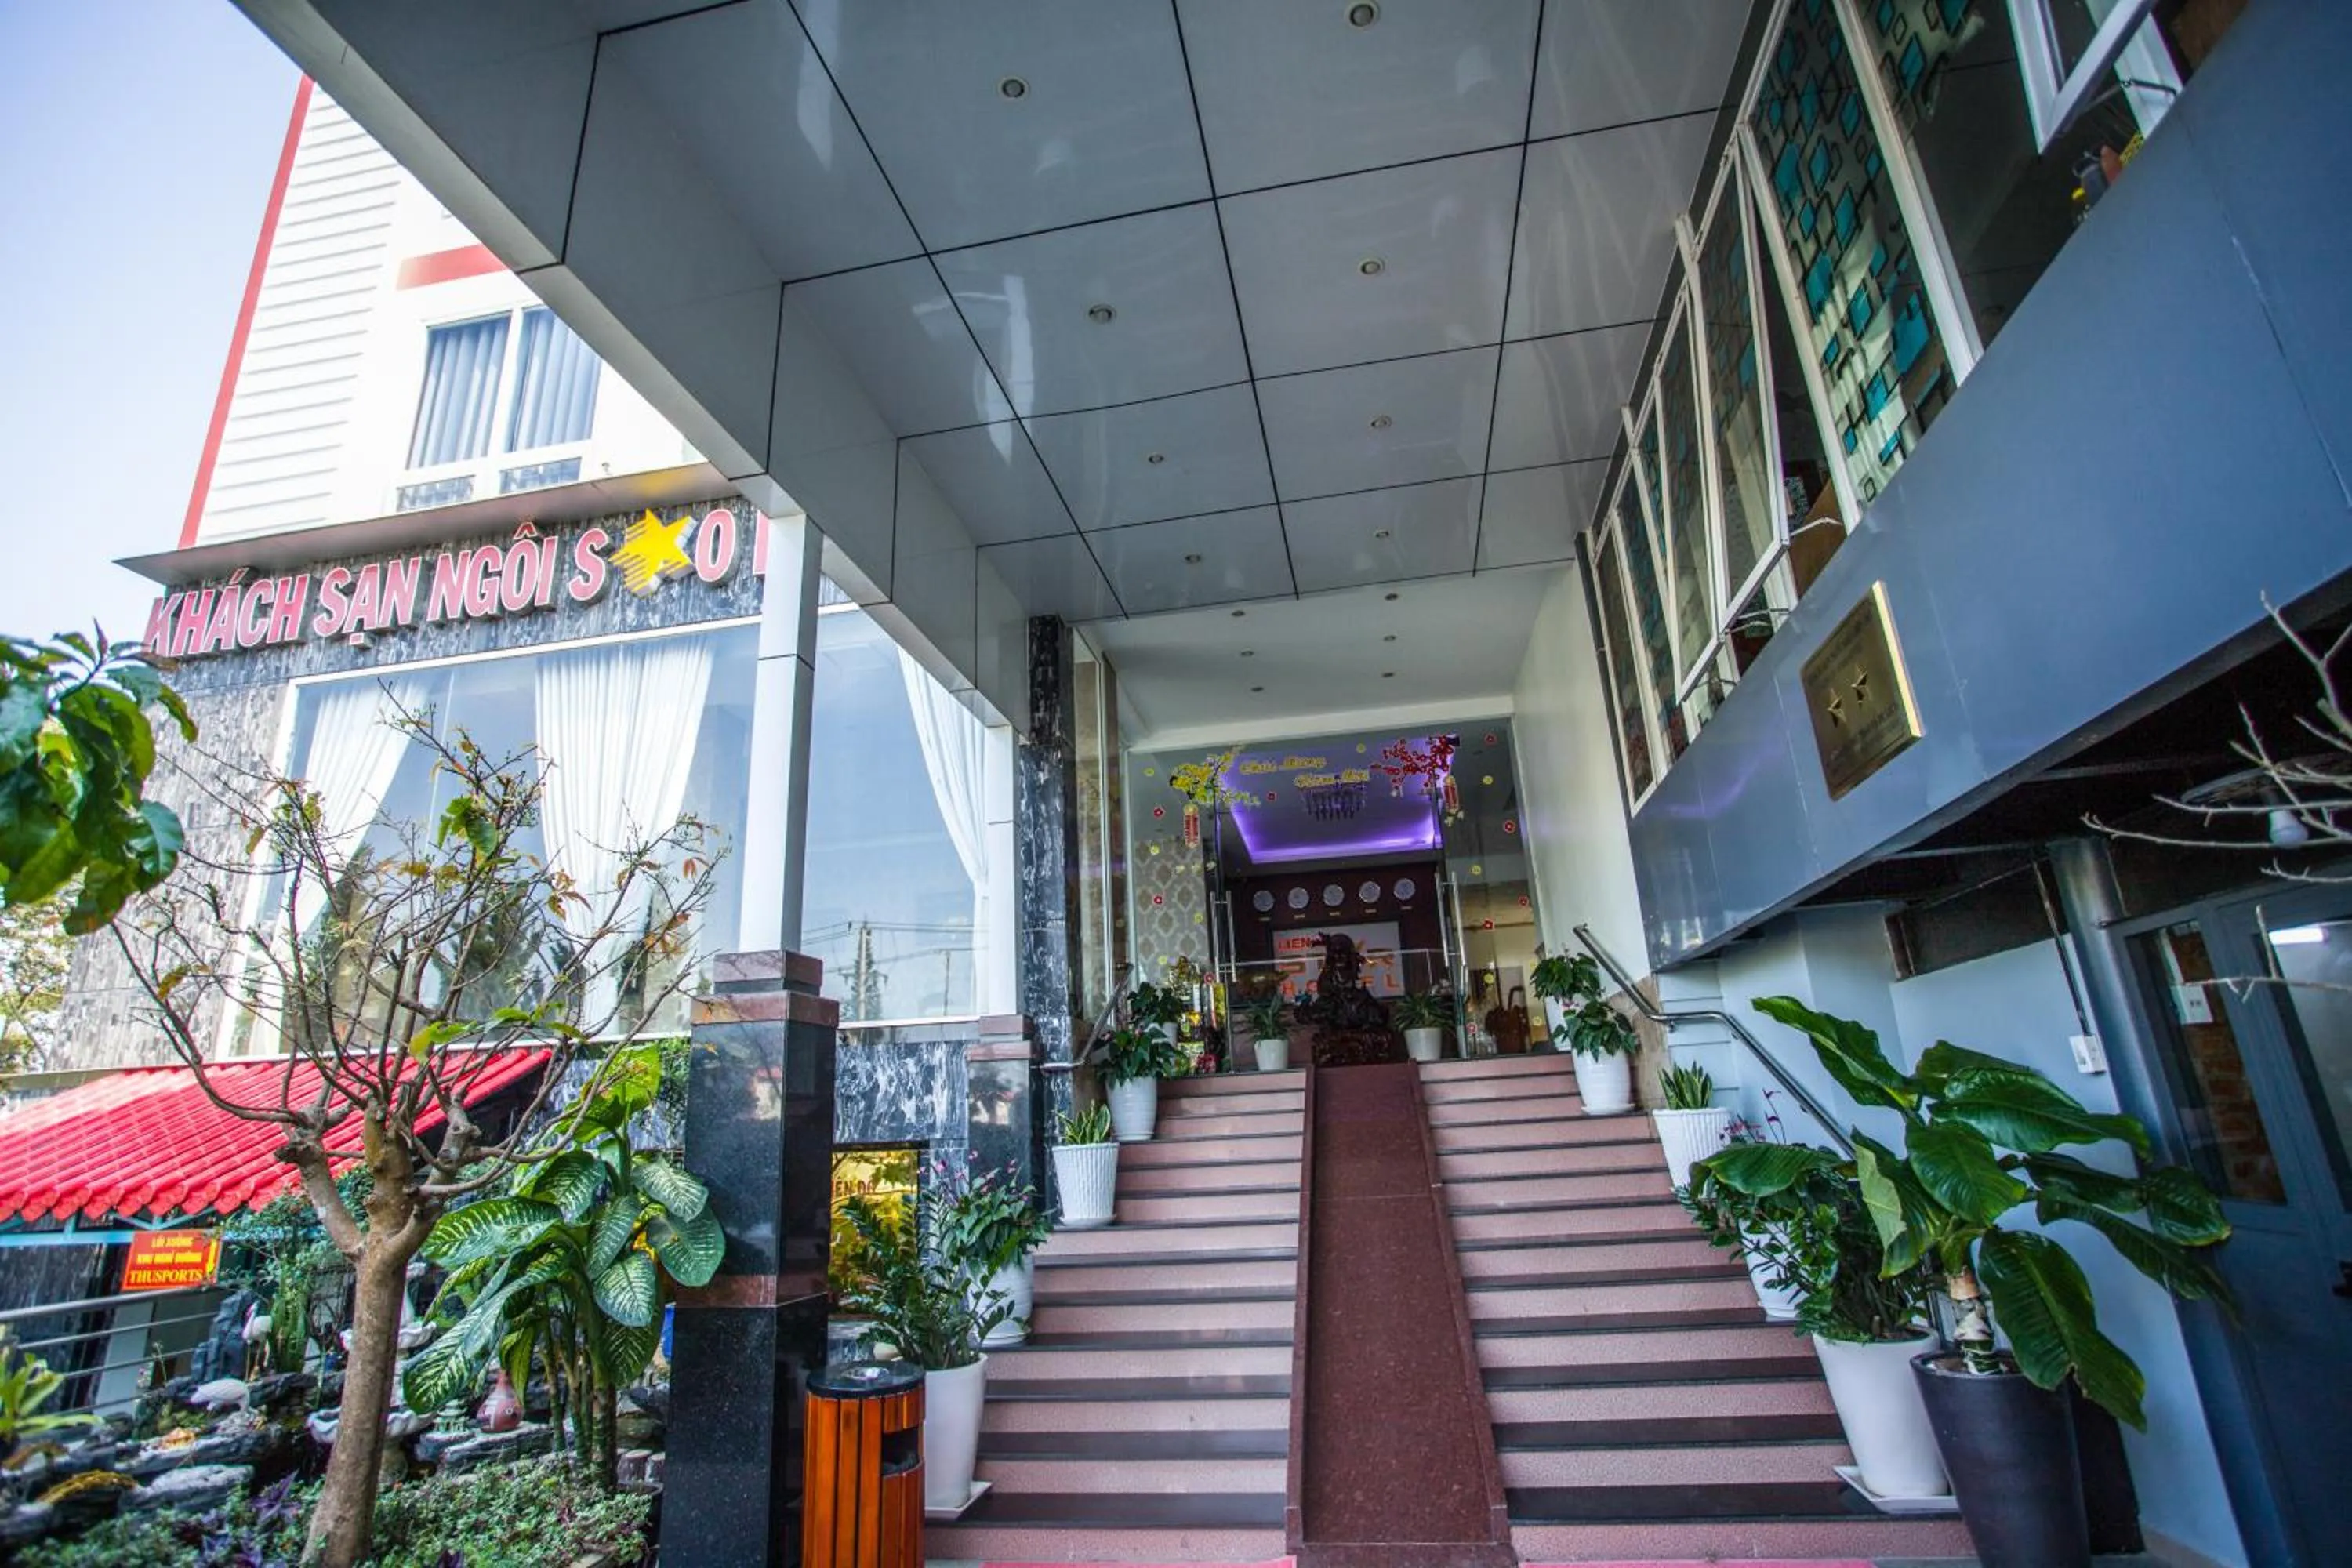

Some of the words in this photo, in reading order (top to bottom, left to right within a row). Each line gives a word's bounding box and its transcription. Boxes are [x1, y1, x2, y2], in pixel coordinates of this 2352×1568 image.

[142, 567, 310, 657] KHÁCH
[314, 556, 422, 645] SẠN
[426, 521, 558, 622] NGÔI
[129, 1269, 204, 1283] THUSPORTS
